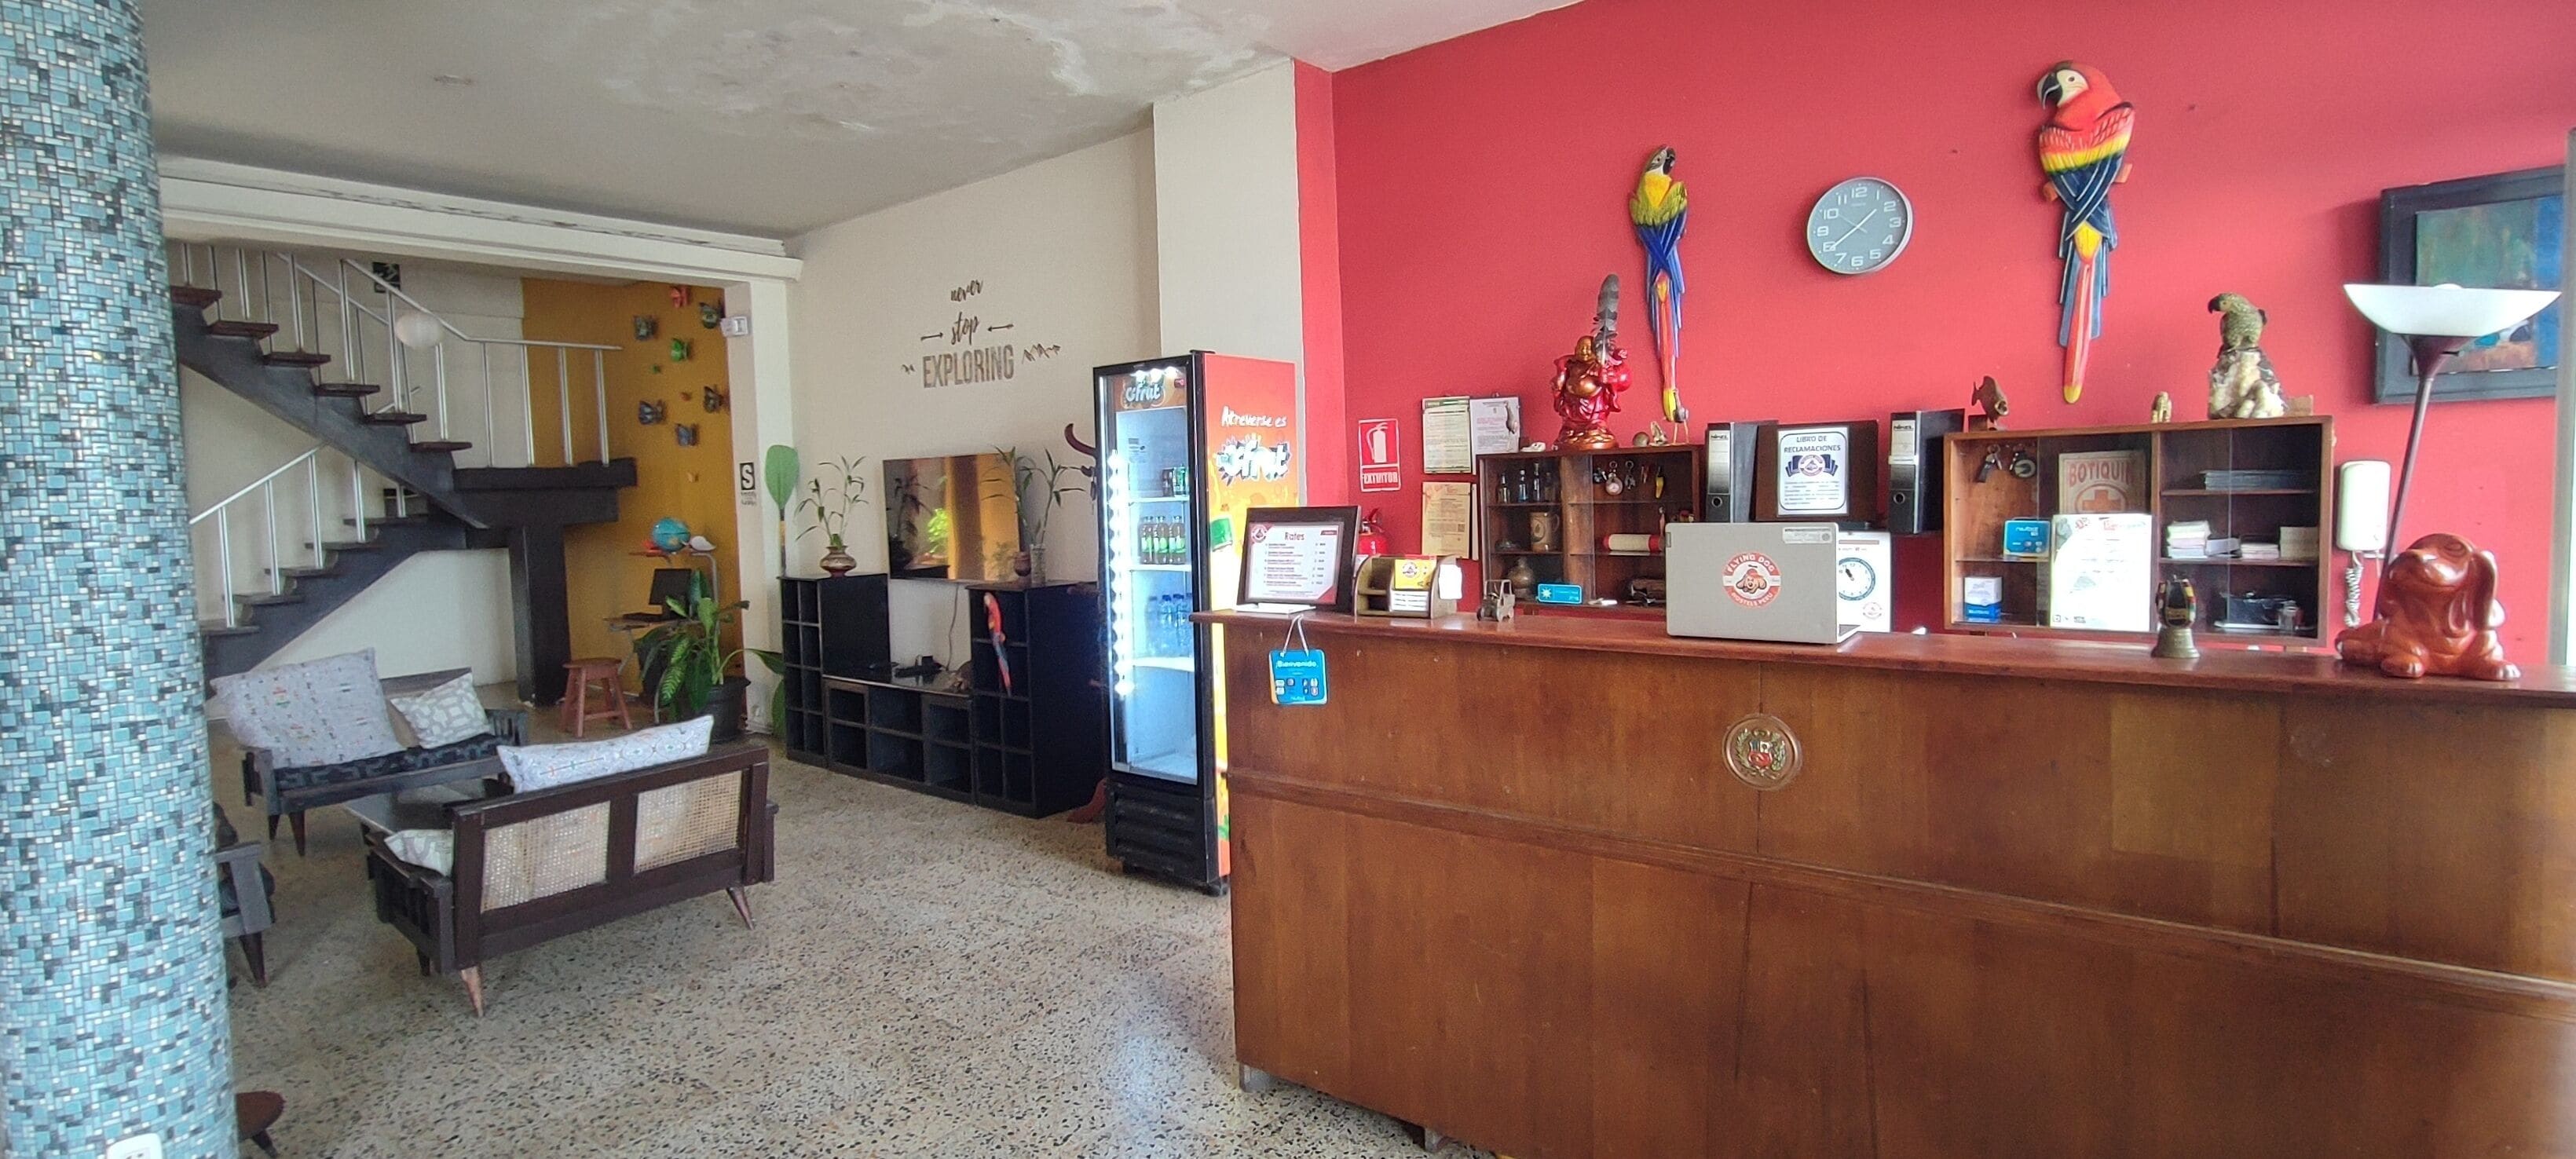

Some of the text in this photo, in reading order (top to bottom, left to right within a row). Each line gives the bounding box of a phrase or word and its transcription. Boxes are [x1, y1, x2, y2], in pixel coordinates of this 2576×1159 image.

[1851, 186, 1868, 199] 12
[1875, 189, 1880, 200] 1
[1838, 195, 1847, 205] 11
[1883, 200, 1896, 212] 2
[1824, 208, 1839, 220] 10
[1889, 217, 1901, 228] 3
[1817, 226, 1829, 236] 9
[1883, 235, 1894, 245] 4
[1835, 252, 1847, 264] 7
[1869, 249, 1882, 259] 5
[1851, 256, 1864, 267] 6
[951, 279, 983, 302] never
[951, 311, 980, 346] stop
[922, 344, 1015, 389] EXPLORING
[1221, 405, 1287, 428] Atreverse es
[1784, 444, 1841, 453] RECLAMACIONES
[741, 464, 754, 489] S
[1284, 532, 1304, 541] Rates
[1758, 556, 1776, 572] DOG
[1758, 591, 1773, 605] PERU
